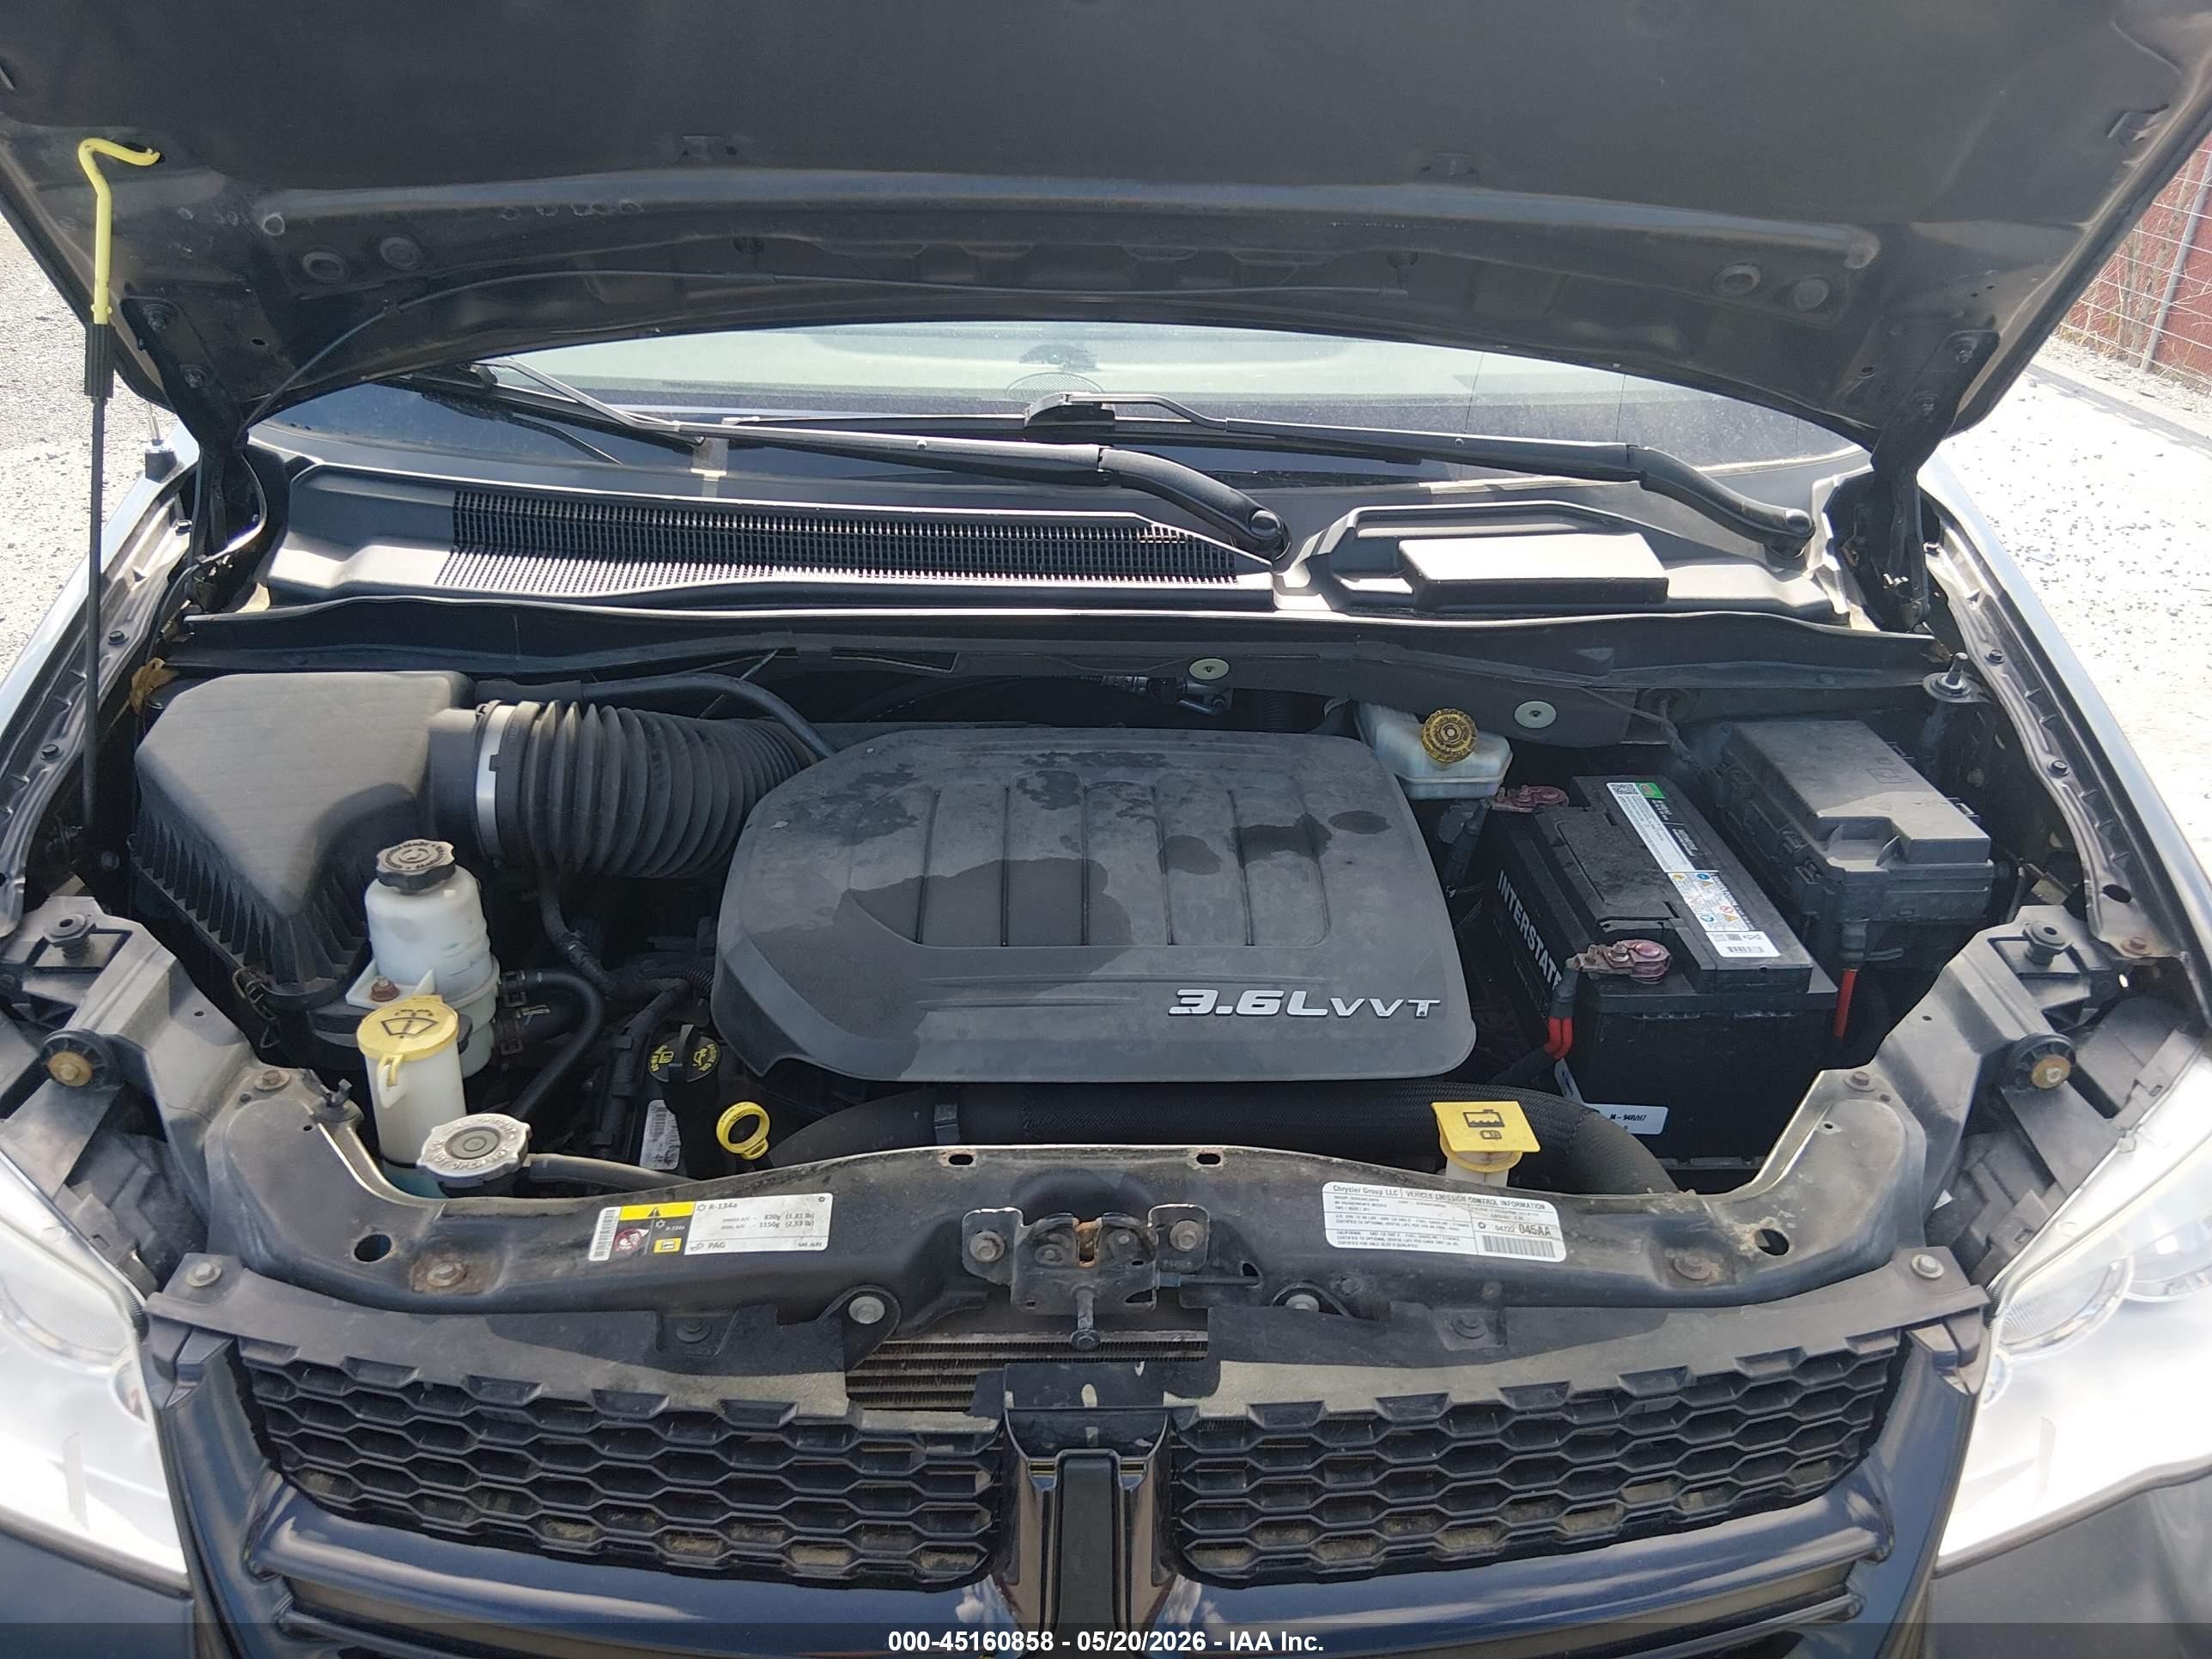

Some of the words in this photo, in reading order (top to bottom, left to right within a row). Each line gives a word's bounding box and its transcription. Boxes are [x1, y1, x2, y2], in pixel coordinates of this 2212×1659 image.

[1333, 1185, 1361, 1194] Chrysler
[1363, 1187, 1383, 1196] Group
[1385, 1188, 1399, 1196] LLC
[1406, 1190, 1433, 1200] VEHICLE
[1435, 1193, 1467, 1203] EMISSION
[1468, 1196, 1498, 1206] CONTROL
[1500, 1200, 1546, 1210] INFORMATION
[1518, 1224, 1552, 1237] 045AA
